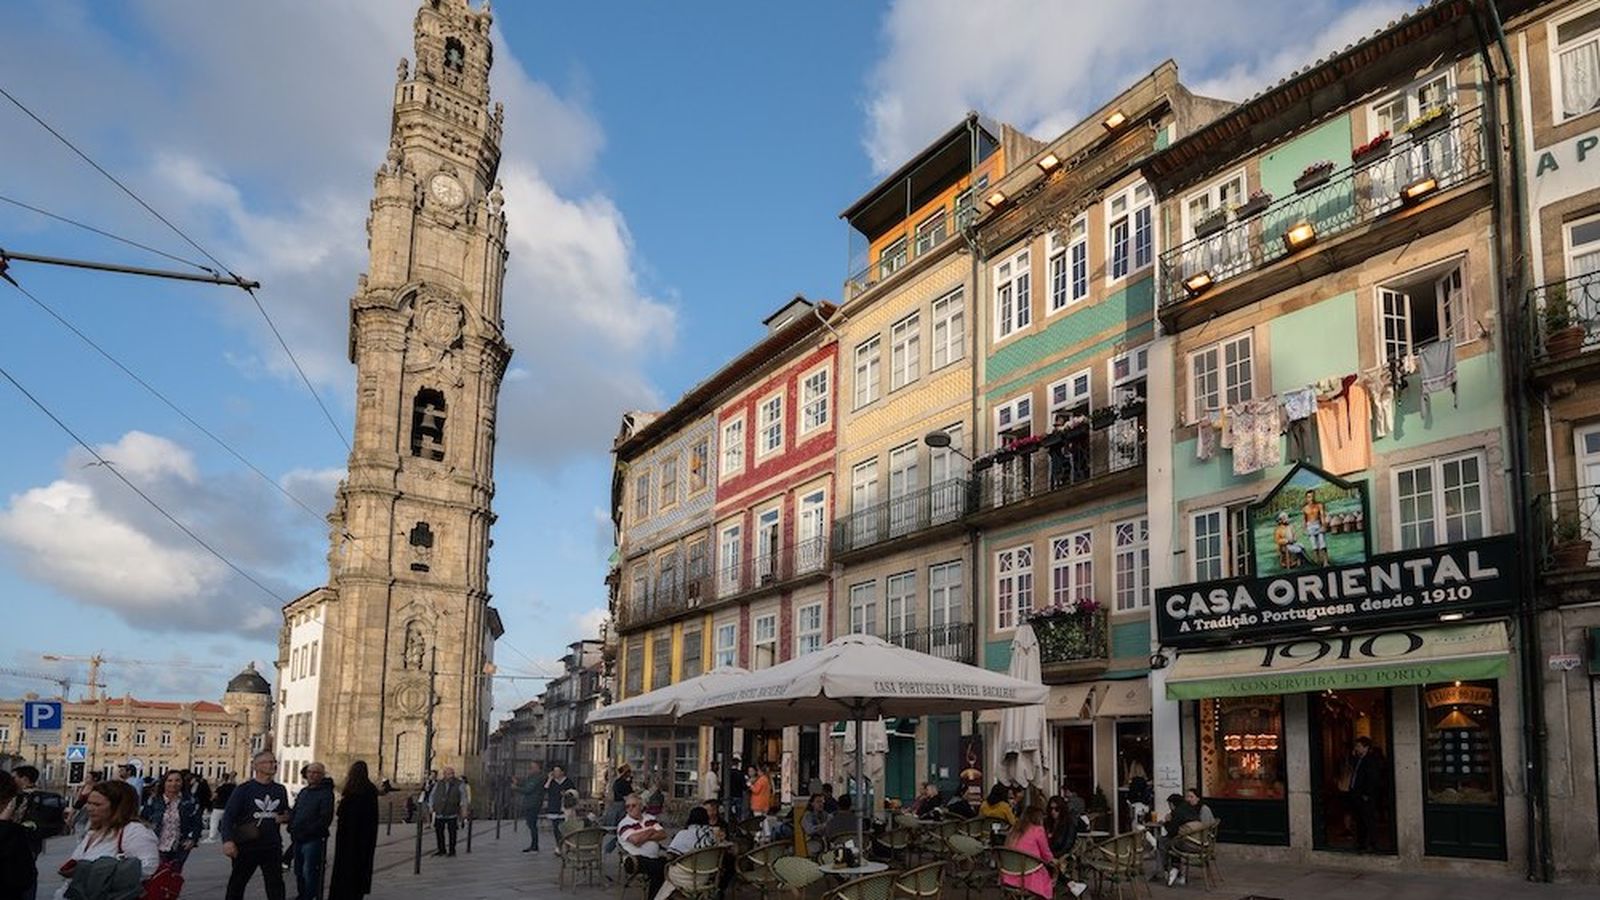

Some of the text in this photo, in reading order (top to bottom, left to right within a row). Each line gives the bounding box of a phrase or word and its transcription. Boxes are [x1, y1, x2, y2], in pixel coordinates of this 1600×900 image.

[1165, 550, 1500, 620] CASA ORIENTAL
[1179, 586, 1473, 633] A Tradição Portuguesa desde 1910
[1260, 631, 1424, 667] 1910
[874, 681, 897, 694] CASA
[899, 682, 951, 695] PORTUGUESA
[1238, 675, 1337, 691] CONSERVEIRA
[1344, 670, 1368, 684] DO
[1376, 667, 1432, 682] PORTO
[32, 704, 55, 728] P
